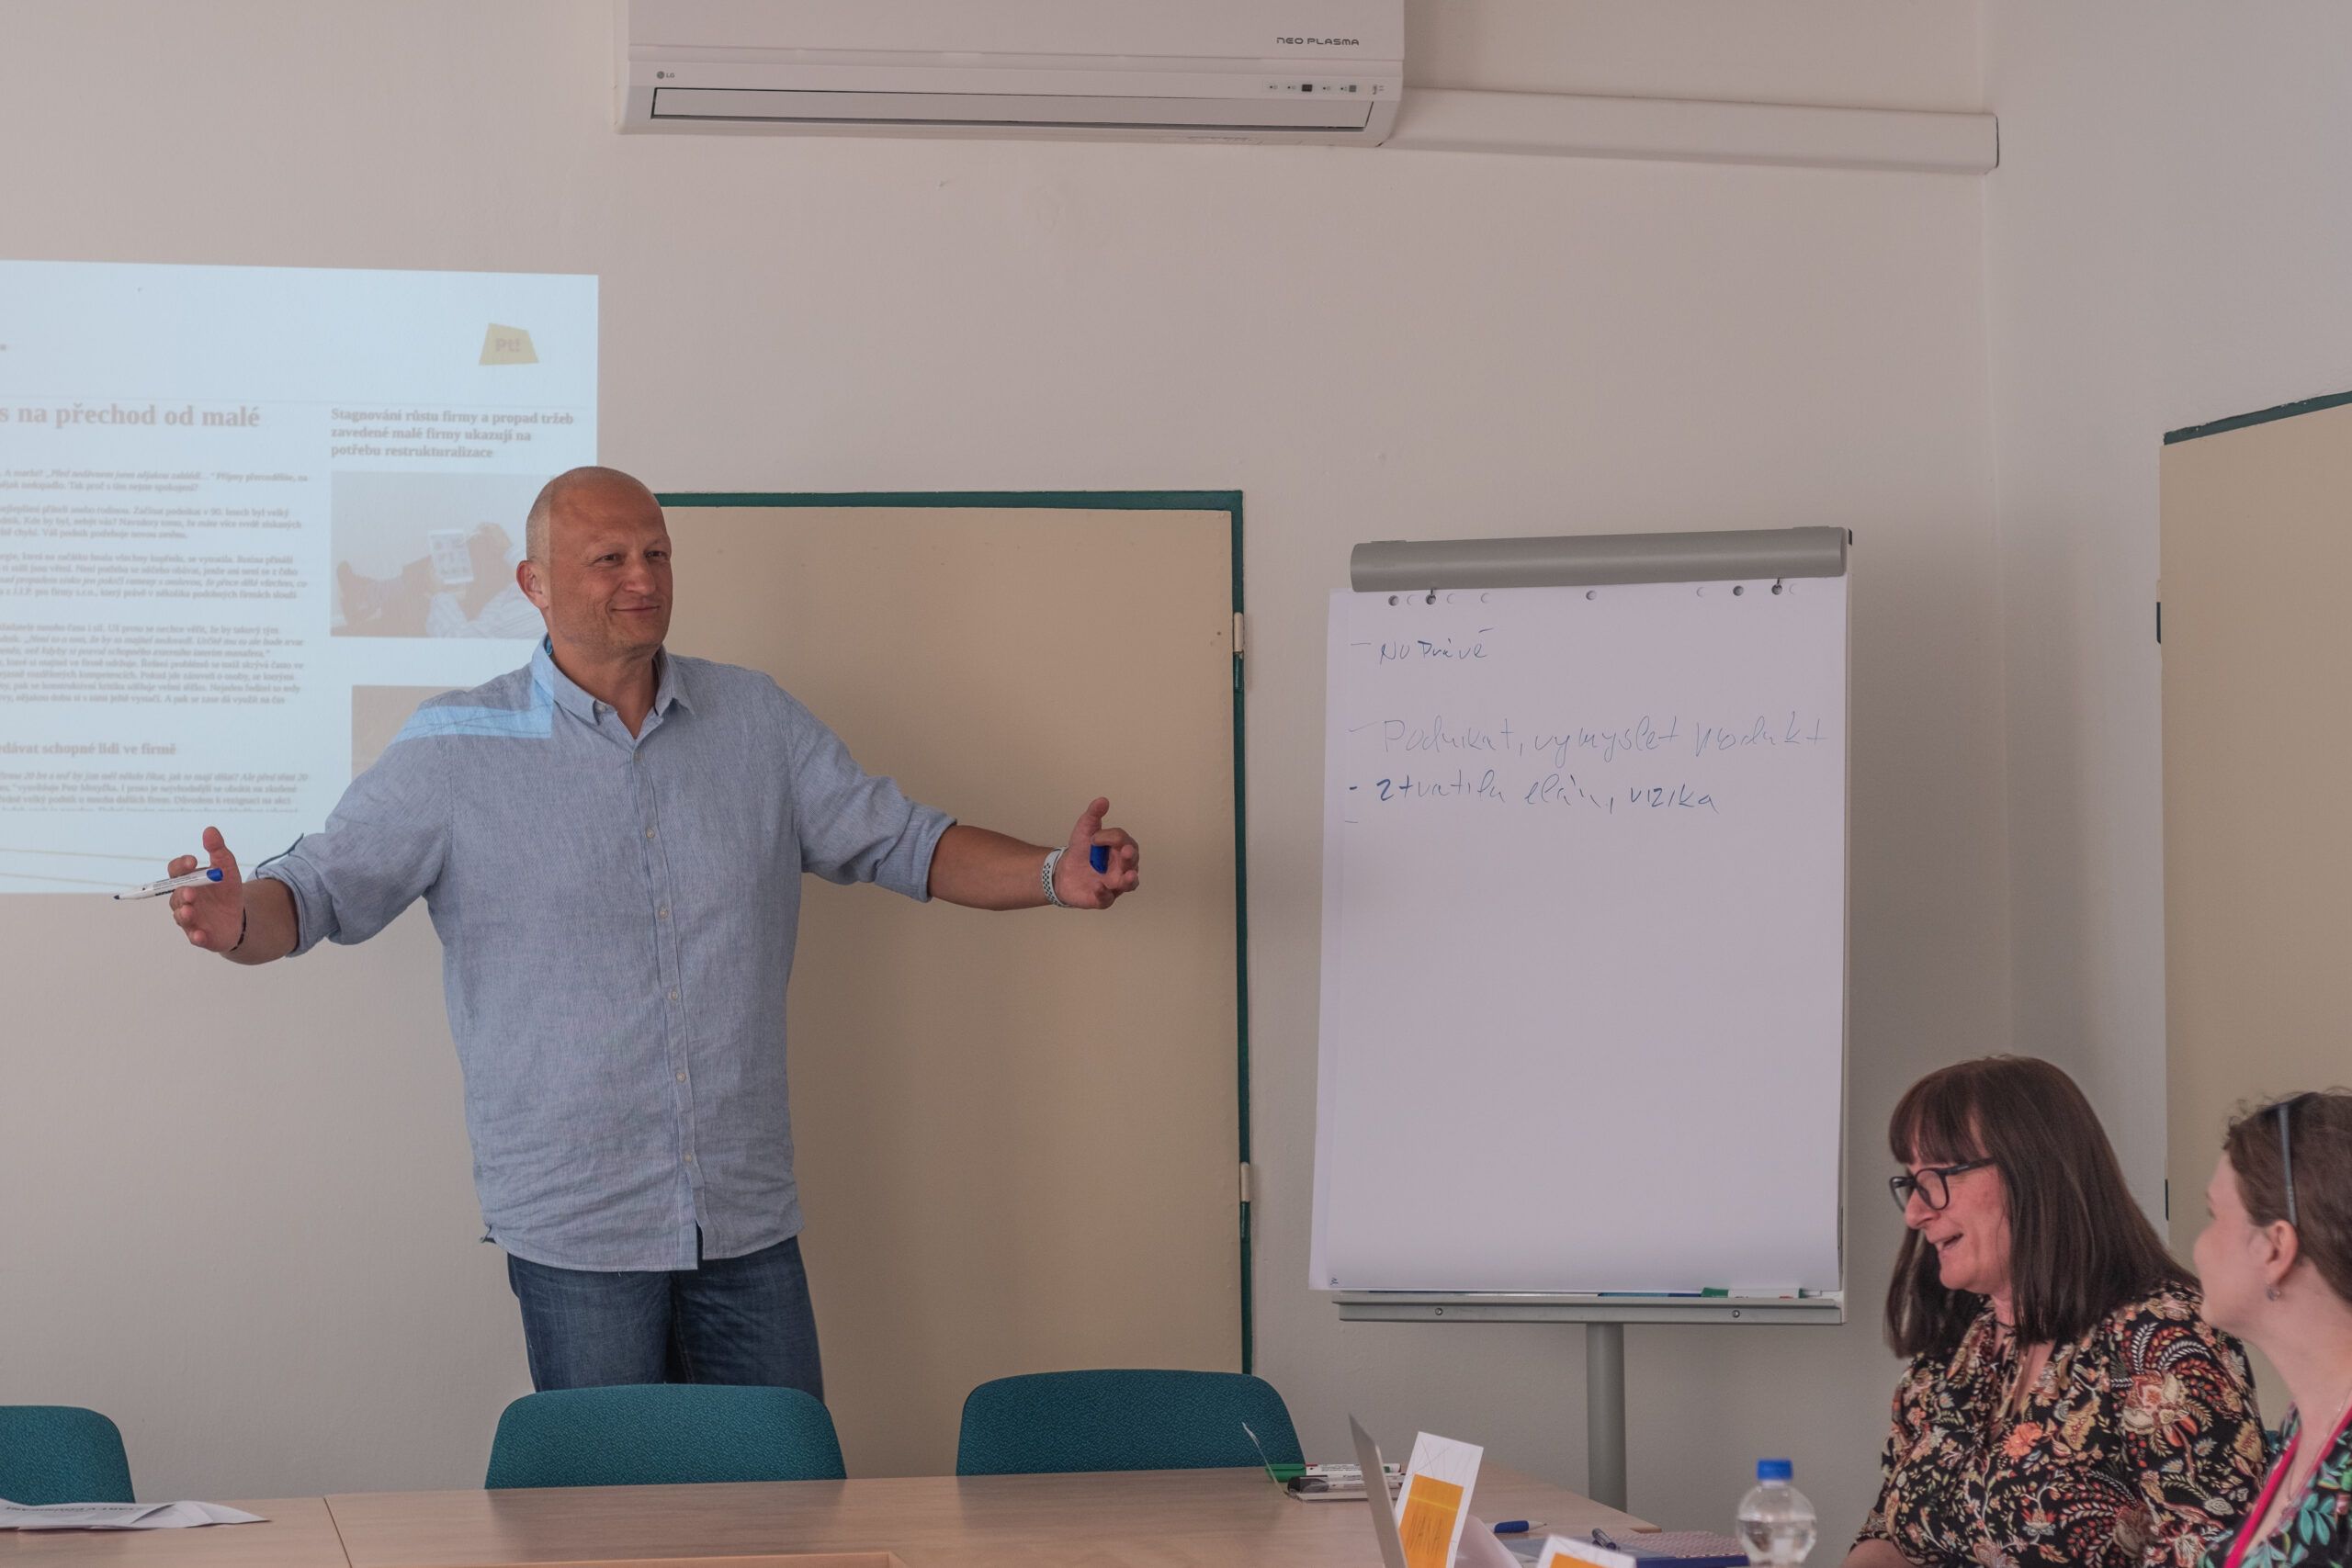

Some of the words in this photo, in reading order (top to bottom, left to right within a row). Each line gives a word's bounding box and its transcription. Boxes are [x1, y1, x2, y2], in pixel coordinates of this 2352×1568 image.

[1307, 38, 1360, 46] PLASMA
[17, 406, 46, 423] na
[55, 402, 156, 429] přechod
[164, 405, 194, 427] od
[201, 406, 260, 427] malé
[331, 408, 401, 423] Stagnování
[405, 409, 439, 422] růstu
[442, 410, 478, 424] firmy
[481, 414, 489, 423] a
[492, 411, 538, 425] propad
[541, 412, 574, 424] tržeb
[331, 426, 390, 438] zavedené
[392, 427, 424, 439] malé
[425, 428, 460, 442] firmy
[464, 429, 513, 443] ukazují
[515, 432, 531, 441] na
[331, 444, 381, 457] potřebu
[384, 446, 493, 458] restrukturalizace
[42, 740, 95, 757] schopné
[98, 741, 119, 754] lidi
[123, 745, 138, 755] ve
[141, 742, 177, 756] firmě
